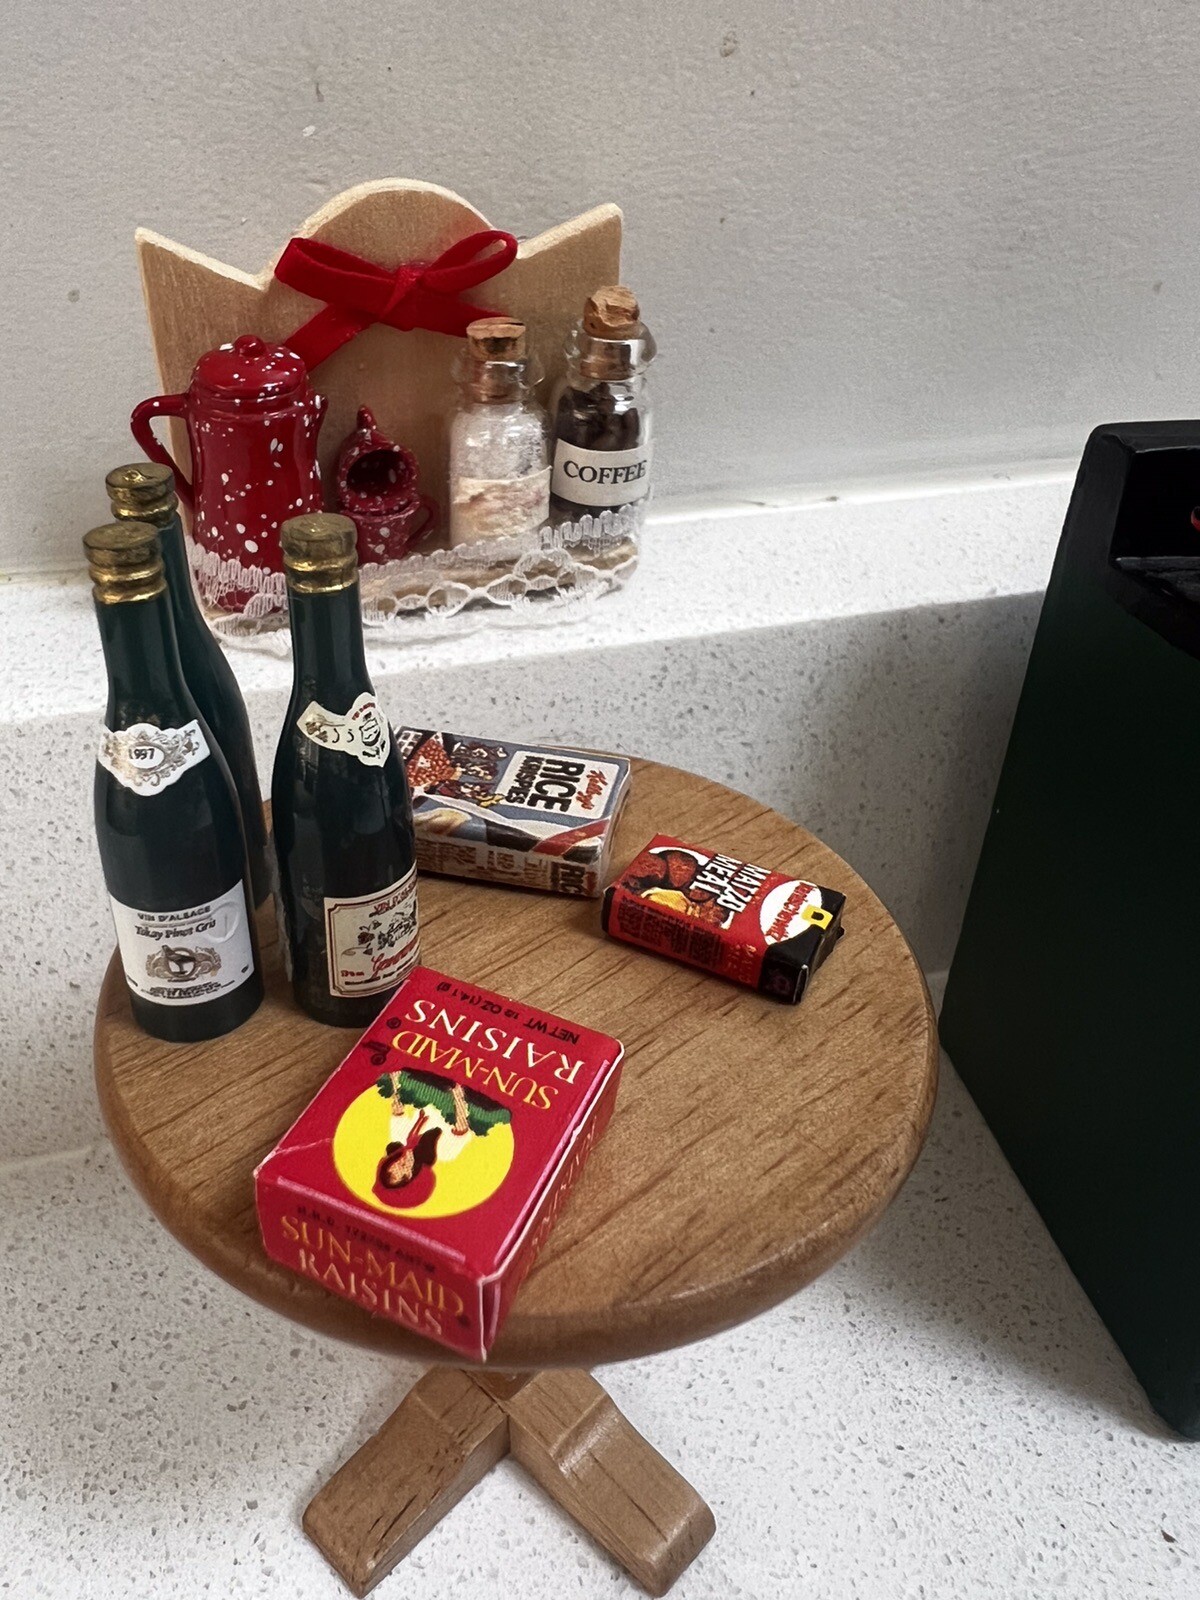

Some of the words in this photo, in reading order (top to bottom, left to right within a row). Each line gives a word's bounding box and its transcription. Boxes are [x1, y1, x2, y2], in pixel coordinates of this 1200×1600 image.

[563, 460, 647, 485] COFFEE
[505, 755, 545, 804] KRISPIES
[527, 758, 586, 812] RICE
[689, 853, 743, 895] MEAL
[716, 863, 772, 912] MATZO
[480, 1000, 502, 1014] OZ
[523, 1017, 548, 1034] WT
[405, 999, 585, 1084] RAISINS
[549, 1026, 580, 1045] NET
[392, 1031, 559, 1110] SUN-MAID
[281, 1215, 464, 1317] SUN-MAID
[299, 1248, 442, 1335] RAISINS
